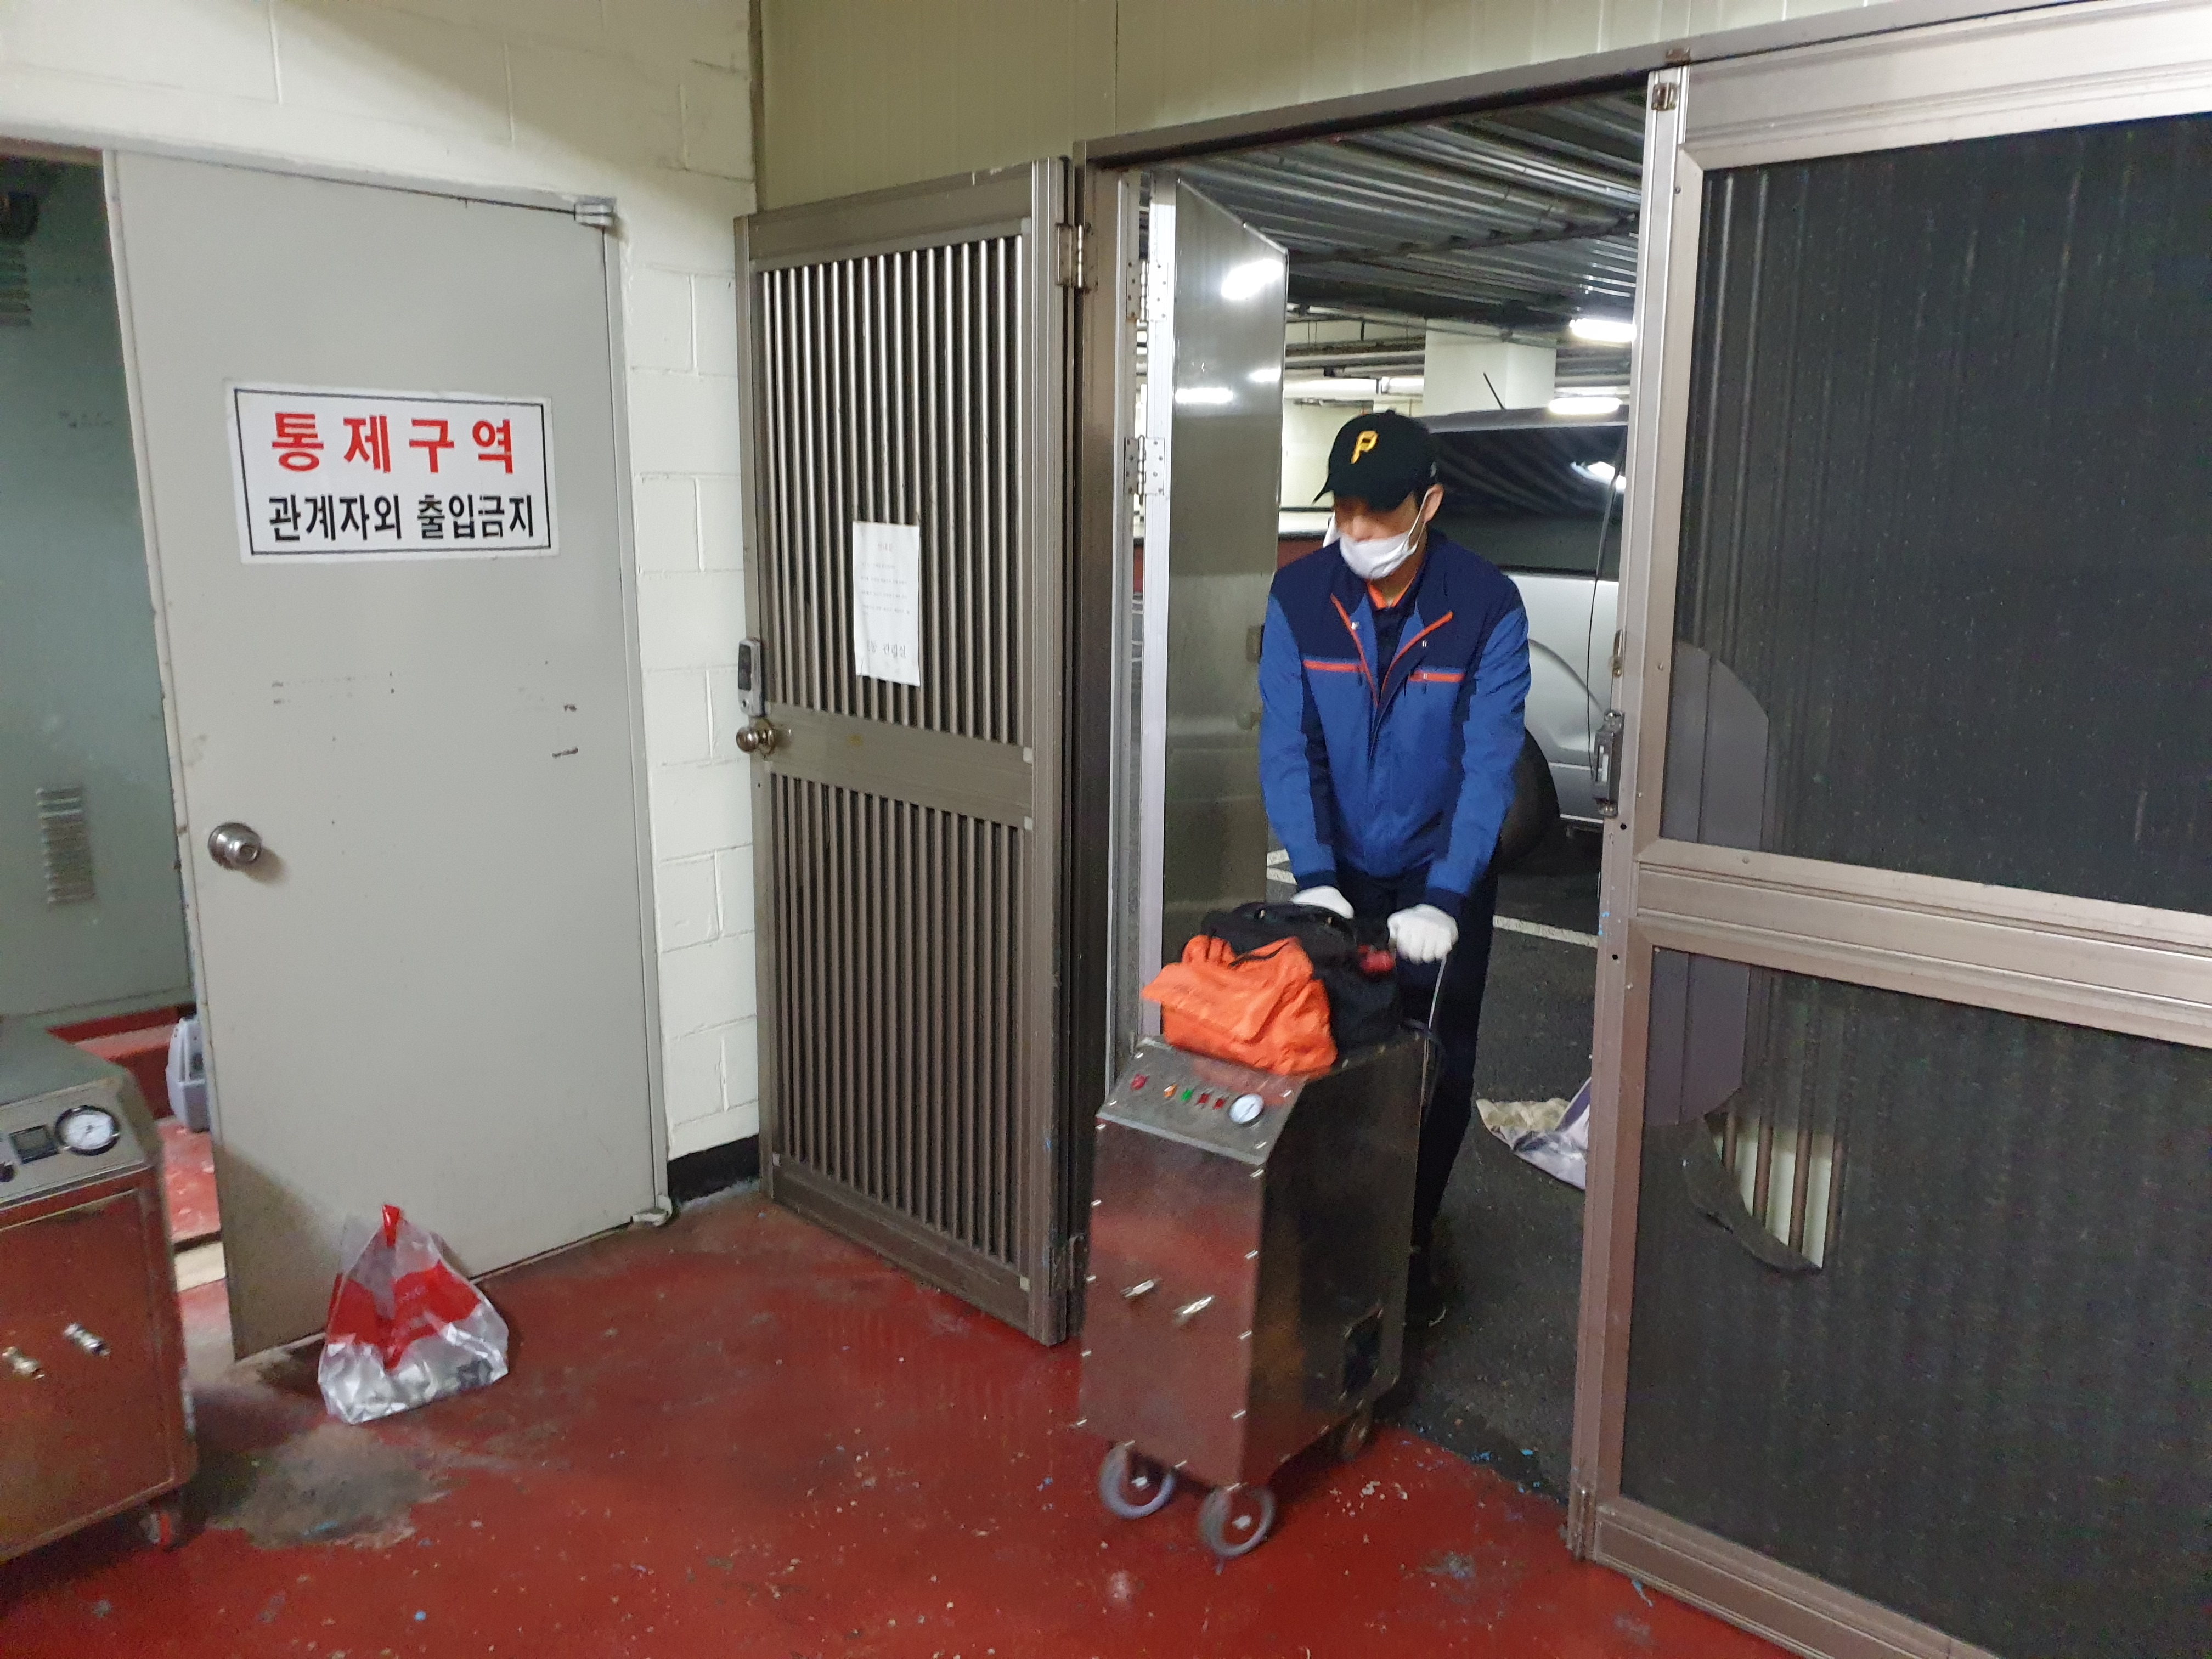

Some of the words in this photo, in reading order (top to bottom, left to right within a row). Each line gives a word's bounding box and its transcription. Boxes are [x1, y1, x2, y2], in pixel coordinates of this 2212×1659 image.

[1350, 430, 1379, 465] P
[269, 494, 402, 541] 관계자외
[416, 494, 534, 540] 출입금지
